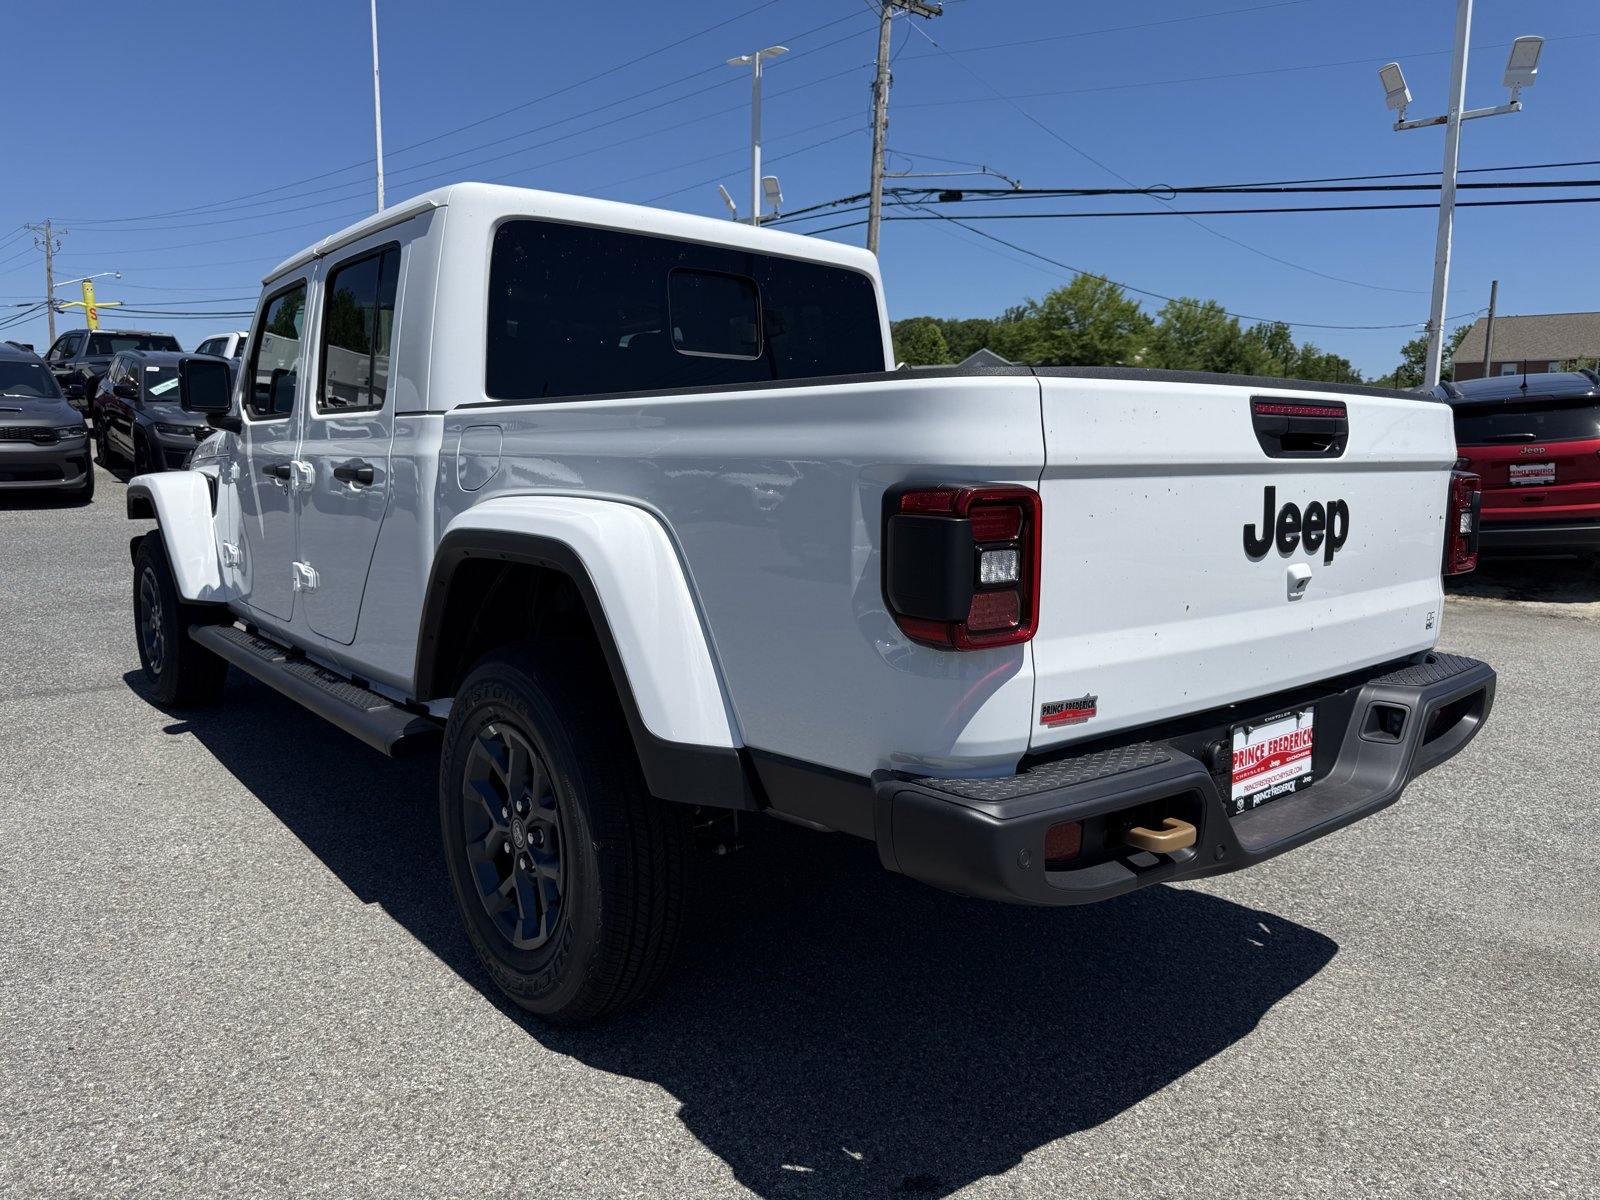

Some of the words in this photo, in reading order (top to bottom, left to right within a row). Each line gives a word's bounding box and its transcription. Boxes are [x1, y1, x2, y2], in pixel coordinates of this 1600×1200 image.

[1243, 485, 1349, 563] Jeep
[1042, 703, 1064, 716] PRINCE
[1065, 699, 1096, 710] FREDERICK
[1264, 711, 1291, 722] CHRYSLER
[1232, 743, 1265, 770] PRINCE
[1268, 727, 1313, 755] FREDERICK
[1235, 766, 1265, 780] CHRYSLER
[1269, 759, 1281, 768] Jeep
[1286, 750, 1311, 762] DODGE
[1253, 789, 1271, 808] PRINCE
[1270, 780, 1296, 798] FREDERICK
